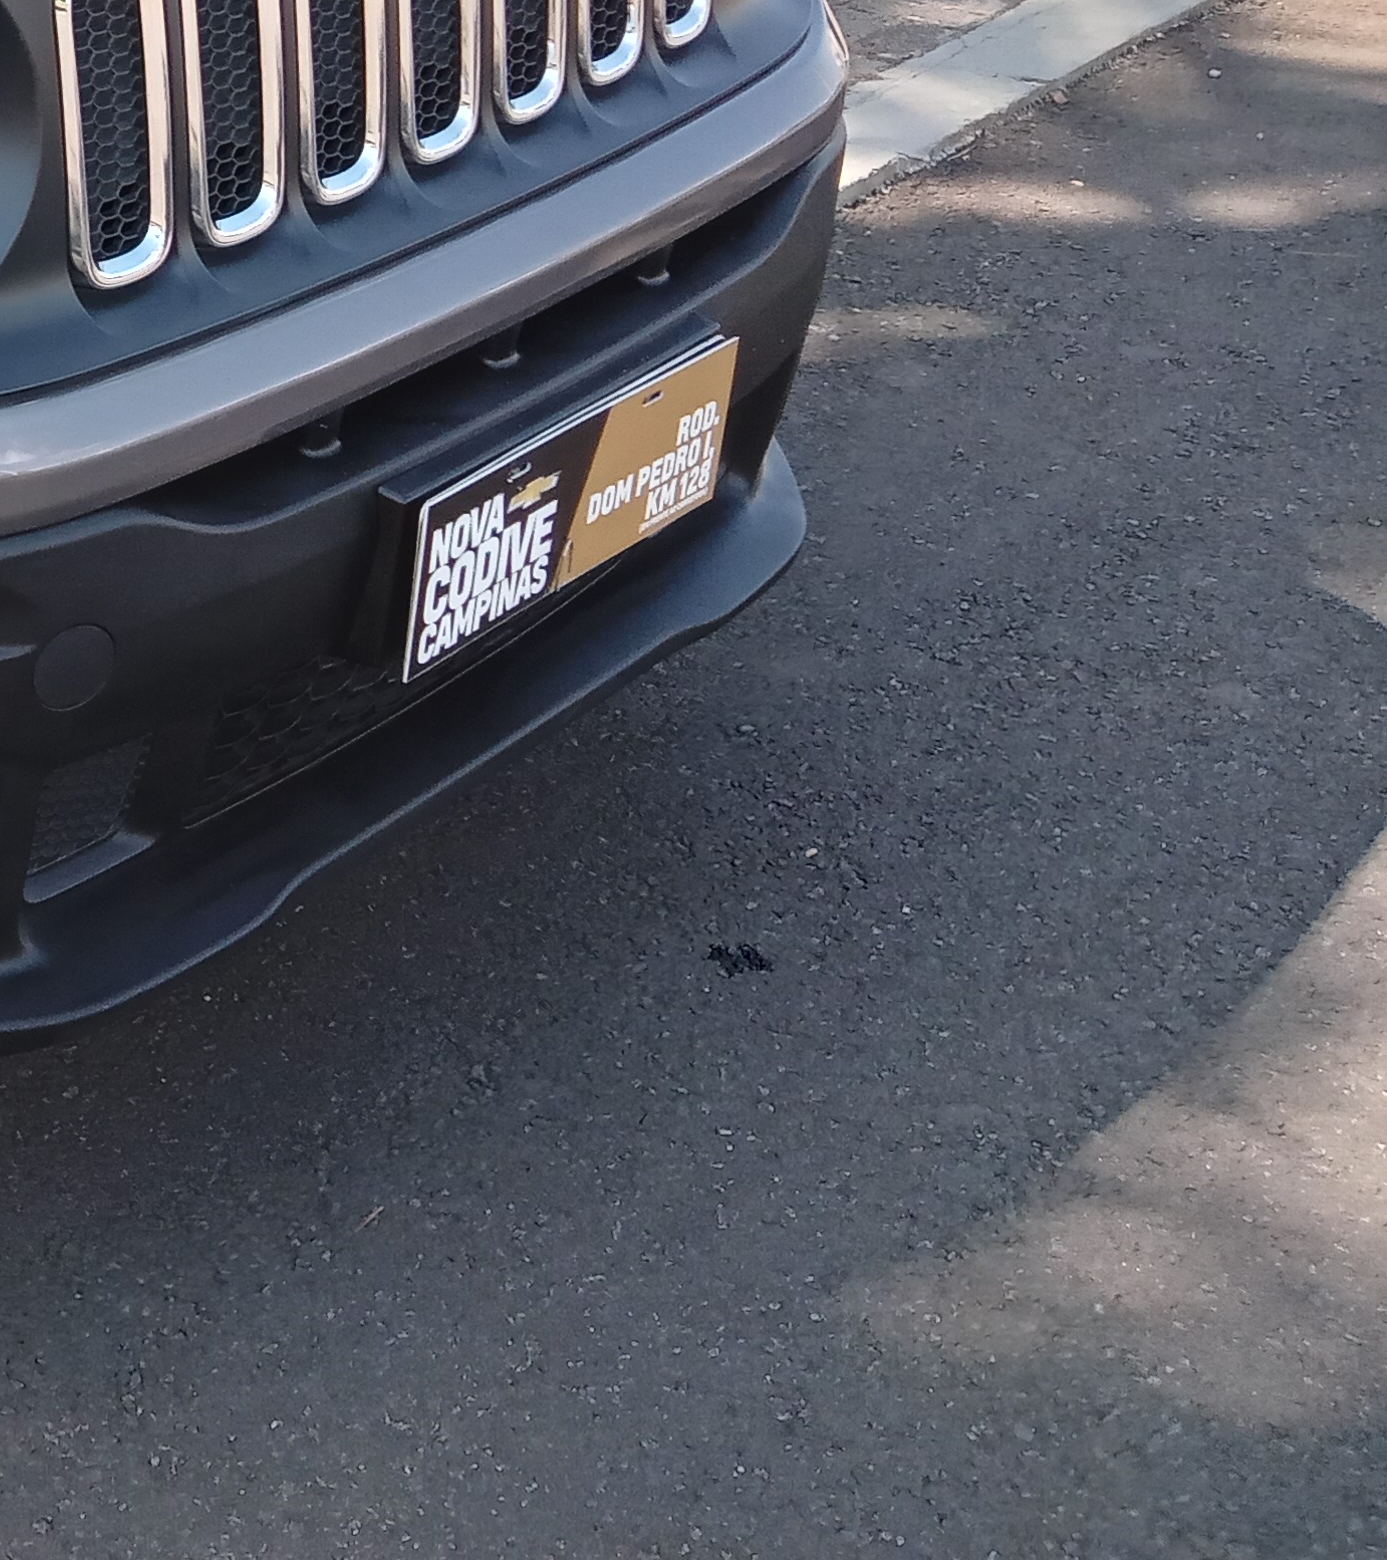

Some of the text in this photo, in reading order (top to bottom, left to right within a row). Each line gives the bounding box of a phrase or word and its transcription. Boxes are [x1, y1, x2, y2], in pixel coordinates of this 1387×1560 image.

[676, 400, 720, 446] ROD.
[586, 473, 635, 525] DOM
[634, 437, 701, 498] PEDRO
[644, 477, 677, 520] KM
[679, 458, 712, 500] 128
[422, 499, 558, 625] CODIVE
[428, 492, 505, 574] NOVA
[417, 554, 549, 665] CAMPINAS
